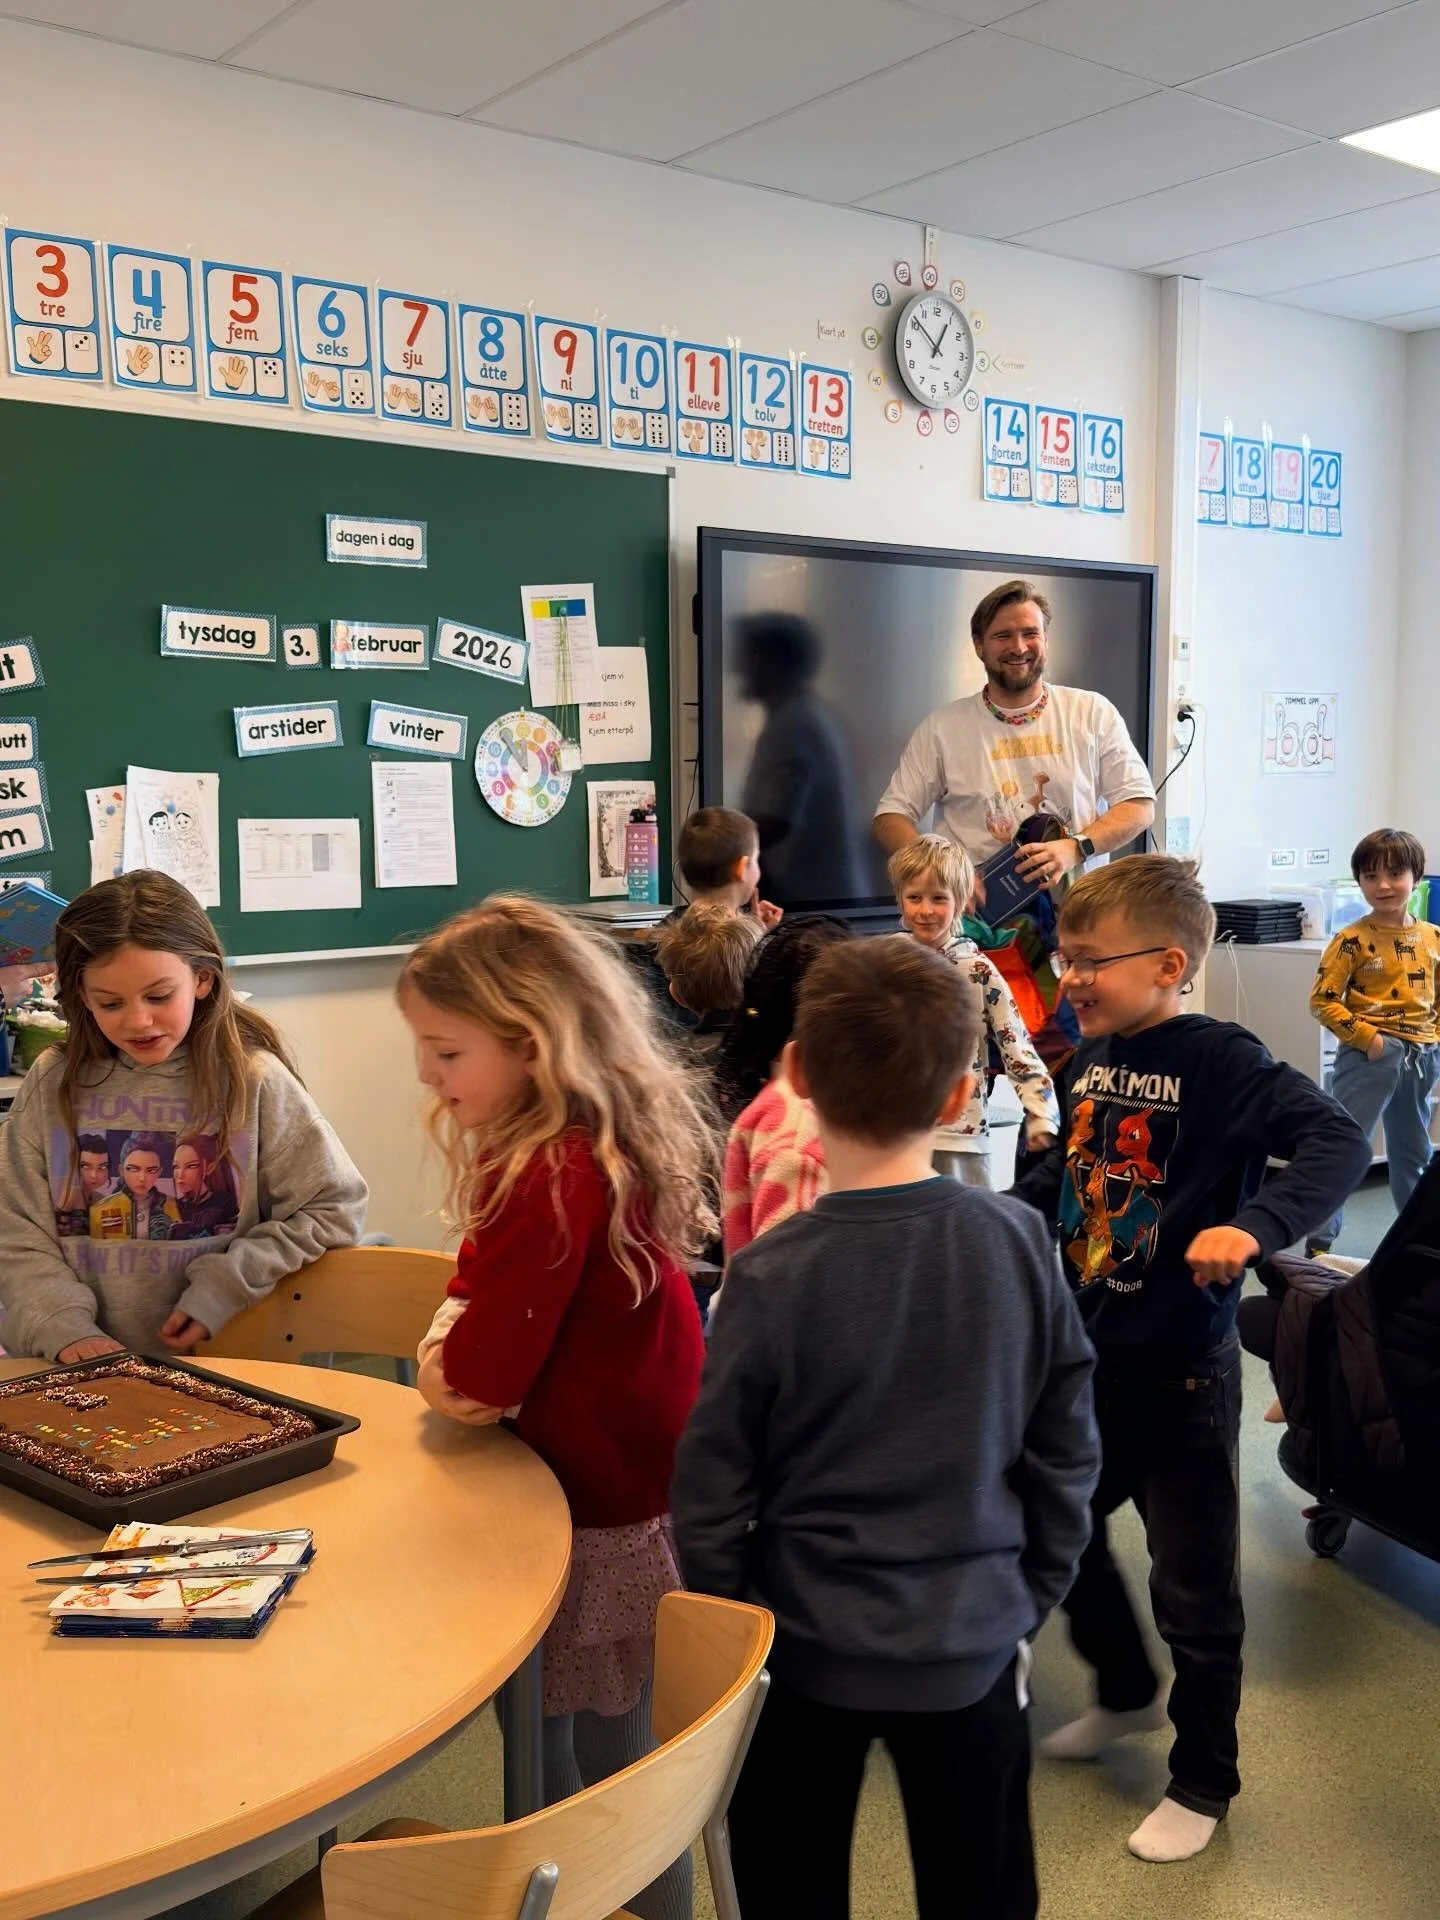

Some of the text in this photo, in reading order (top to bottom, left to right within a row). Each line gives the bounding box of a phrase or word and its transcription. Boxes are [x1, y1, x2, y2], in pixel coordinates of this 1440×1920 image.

[36, 244, 69, 298] 3
[132, 269, 166, 318] 4
[229, 274, 260, 324] 5
[40, 301, 66, 319] tre
[318, 290, 346, 338] 6
[933, 307, 942, 317] 12
[132, 312, 163, 334] fire
[226, 322, 259, 344] fem
[402, 301, 429, 347] 7
[316, 340, 348, 358] seks
[479, 316, 505, 363] 8
[905, 339, 912, 349] 9
[402, 349, 423, 370] sju
[553, 329, 578, 376] 9
[908, 359, 916, 369] 8
[958, 352, 965, 361] 3
[480, 362, 507, 382] åtte
[615, 342, 660, 389] 10
[684, 351, 721, 397] 11
[560, 376, 573, 391] ni
[630, 386, 640, 401] ti
[746, 363, 786, 409] 12
[687, 396, 721, 413] elleve
[808, 374, 845, 418] 13
[755, 407, 777, 424] tolv
[808, 418, 844, 436] tretten
[992, 406, 1025, 445] 14
[1040, 415, 1070, 453] 15
[1088, 421, 1116, 459] 16
[991, 445, 1022, 461] fjorten
[1041, 451, 1070, 467] femten
[1207, 440, 1221, 473] 7
[1236, 445, 1261, 480] 18
[1275, 450, 1299, 485] 19
[1311, 456, 1339, 490] 20
[336, 530, 415, 550] dagen i dag
[178, 620, 257, 649] tysdag
[289, 634, 312, 657] 3.
[350, 634, 422, 654] februar
[452, 630, 513, 669] 2026
[0, 653, 16, 681] t
[0, 733, 27, 749] utt
[389, 719, 444, 742] vinter
[588, 723, 634, 737] Kjem etterpå
